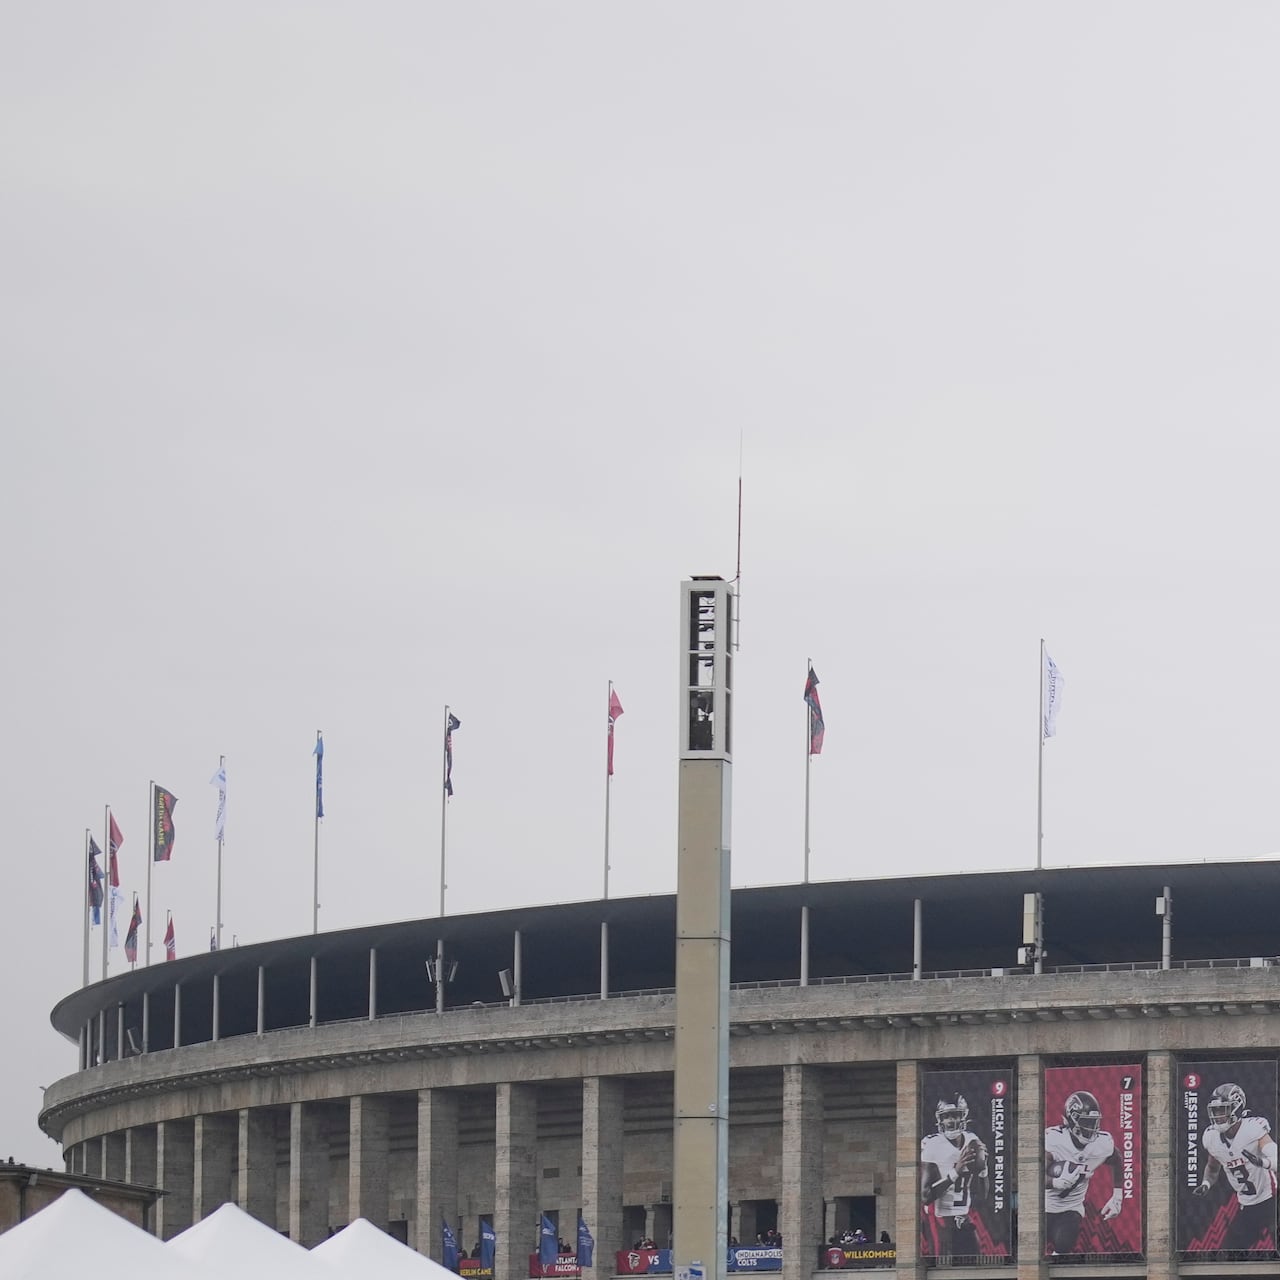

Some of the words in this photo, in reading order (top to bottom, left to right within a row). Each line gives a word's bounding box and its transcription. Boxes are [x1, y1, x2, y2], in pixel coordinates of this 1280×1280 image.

[995, 1081, 1004, 1094] 9
[1123, 1077, 1132, 1089] 7
[1188, 1075, 1196, 1087] 3
[1123, 1093, 1133, 1130] BIJAN
[1187, 1091, 1198, 1130] JESSIE
[994, 1098, 1005, 1151] MICHAEL
[1187, 1133, 1198, 1171] BATES
[994, 1156, 1005, 1192] PENIX
[1123, 1132, 1133, 1199] ROBINSON
[1187, 1173, 1198, 1187] III
[994, 1193, 1005, 1213] JR.
[648, 1254, 660, 1265] VS
[736, 1250, 783, 1259] INDIANAPOLIS
[737, 1258, 758, 1267] COLTS
